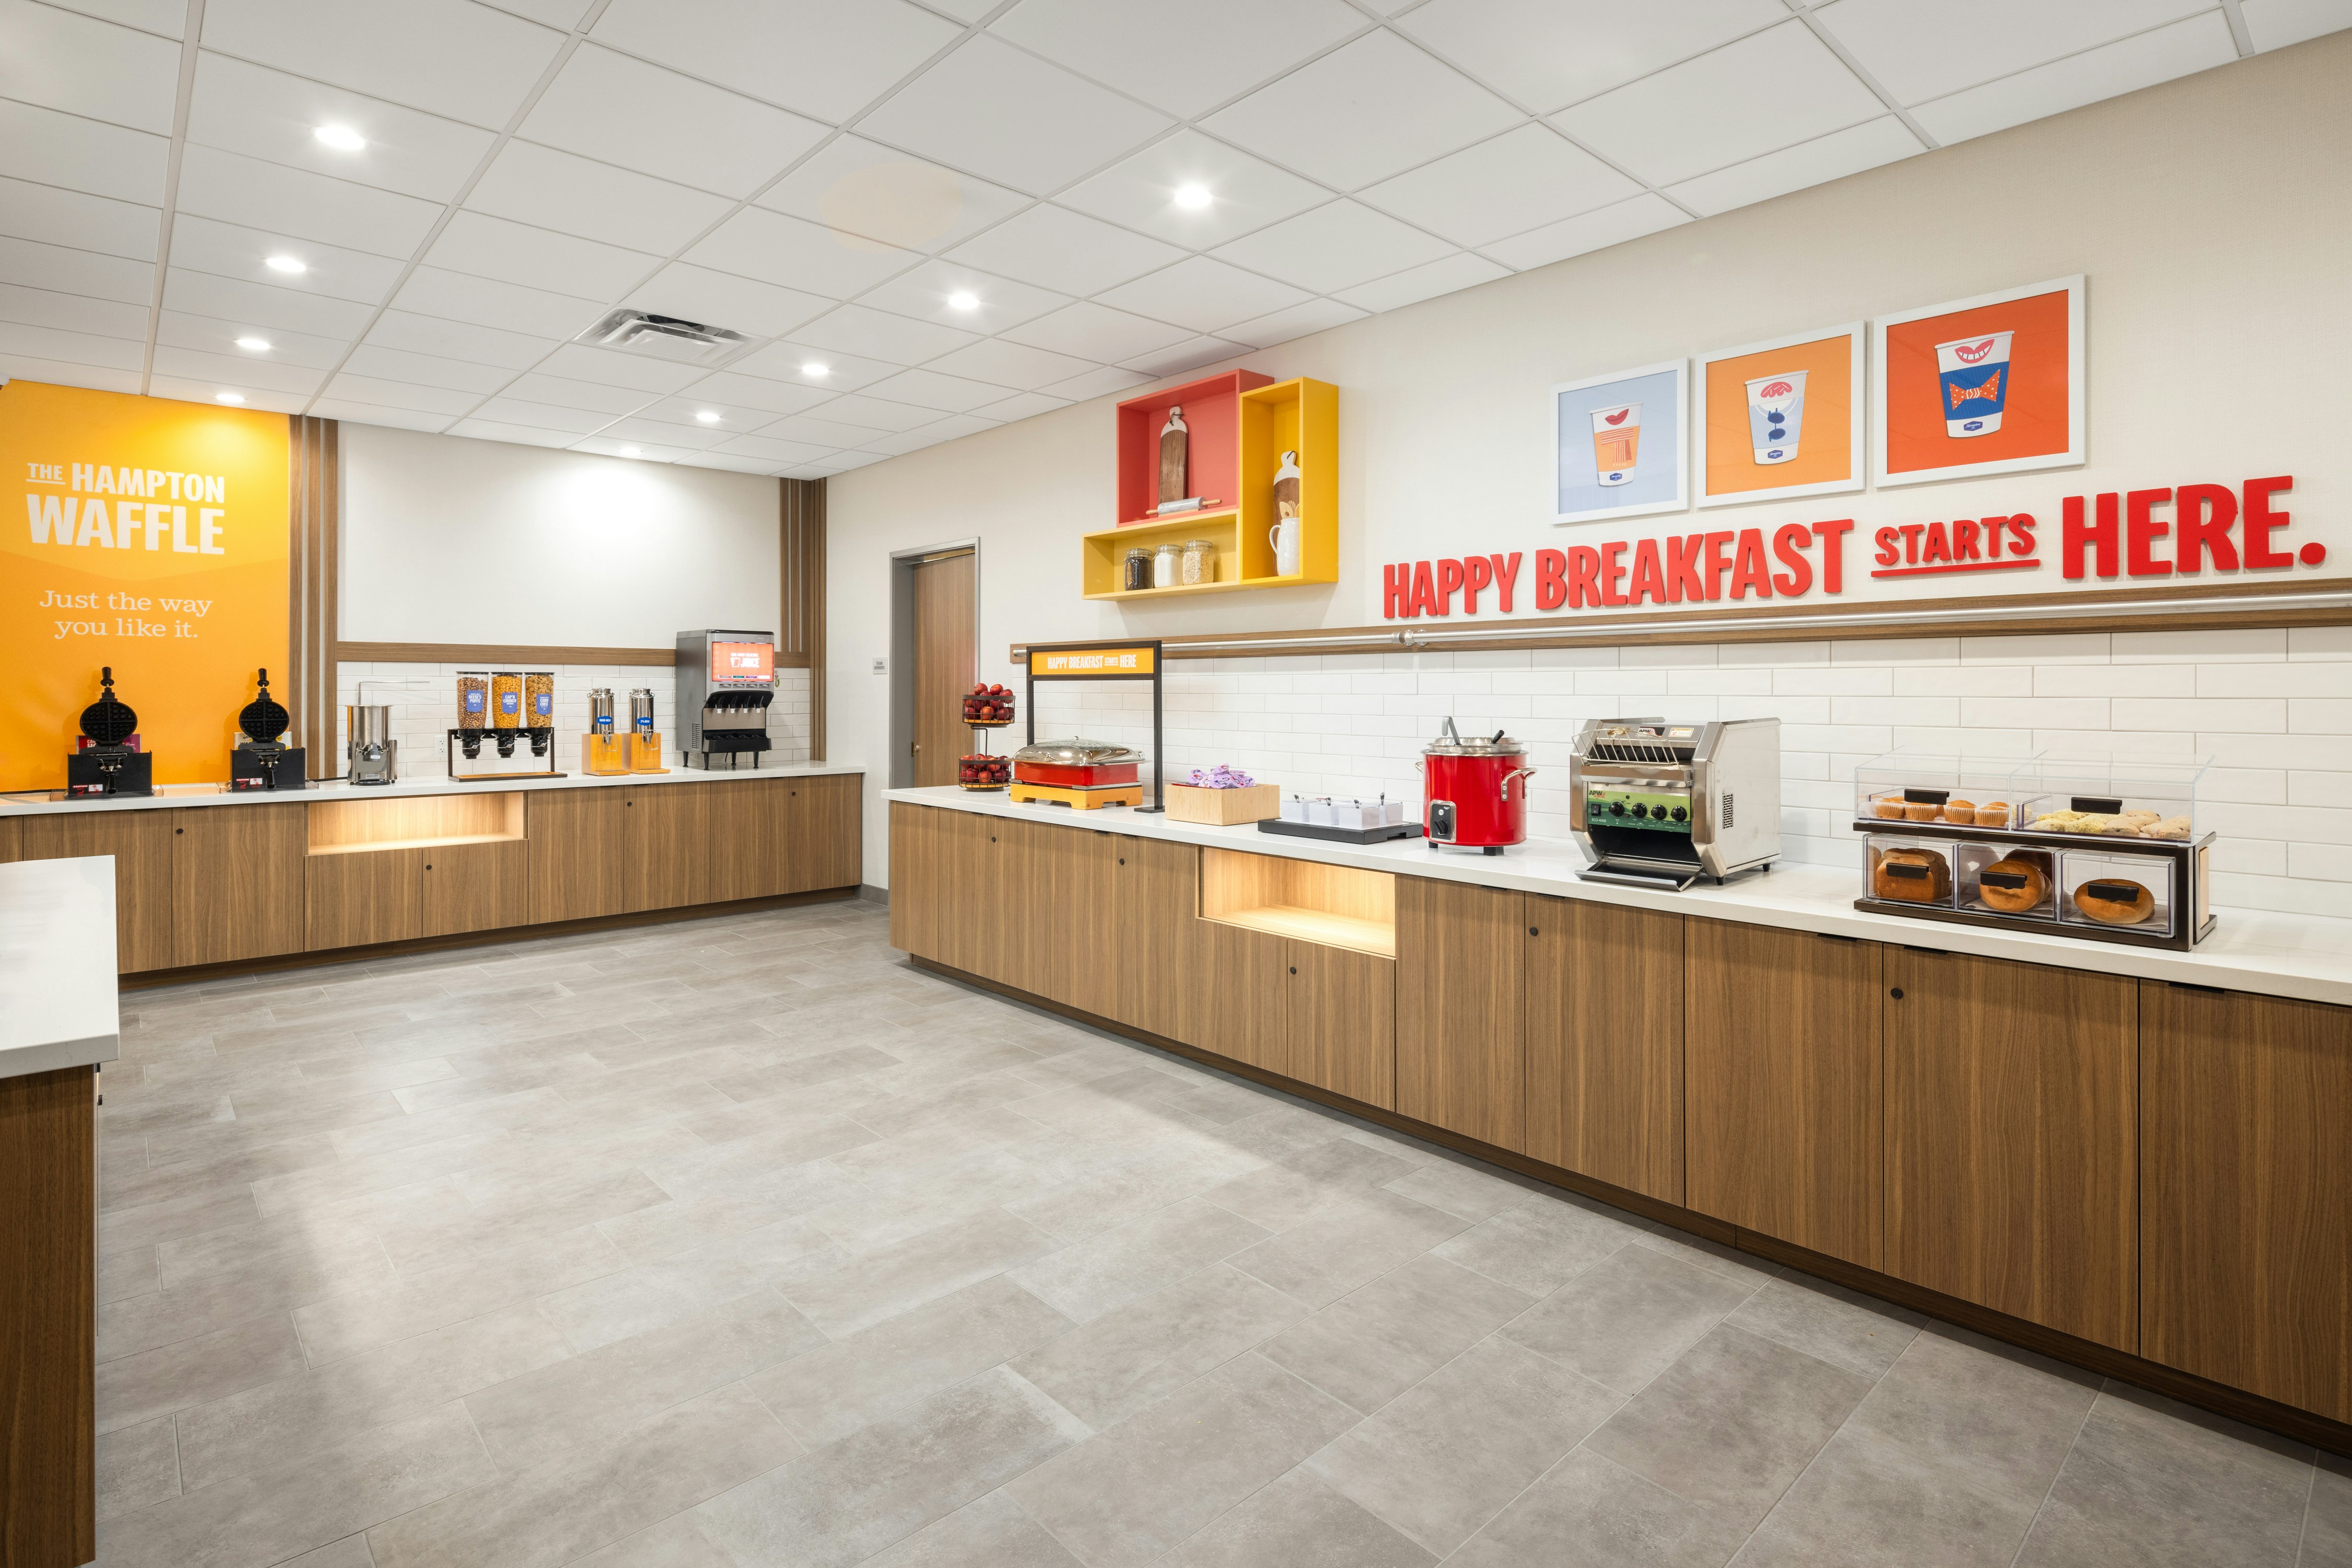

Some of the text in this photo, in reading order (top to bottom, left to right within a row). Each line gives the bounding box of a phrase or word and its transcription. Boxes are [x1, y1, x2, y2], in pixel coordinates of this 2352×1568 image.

[27, 463, 225, 503] THE HAMPTON
[26, 494, 225, 555] WAFFLE
[1384, 475, 2326, 618] HAPPY BREAKFAST STARTS HERE.
[40, 590, 213, 618] Just the way
[54, 618, 198, 639] you like it.
[1047, 656, 1067, 669] HAPPY
[1069, 655, 1103, 668] BREAKFAST
[1120, 654, 1137, 668] HERE
